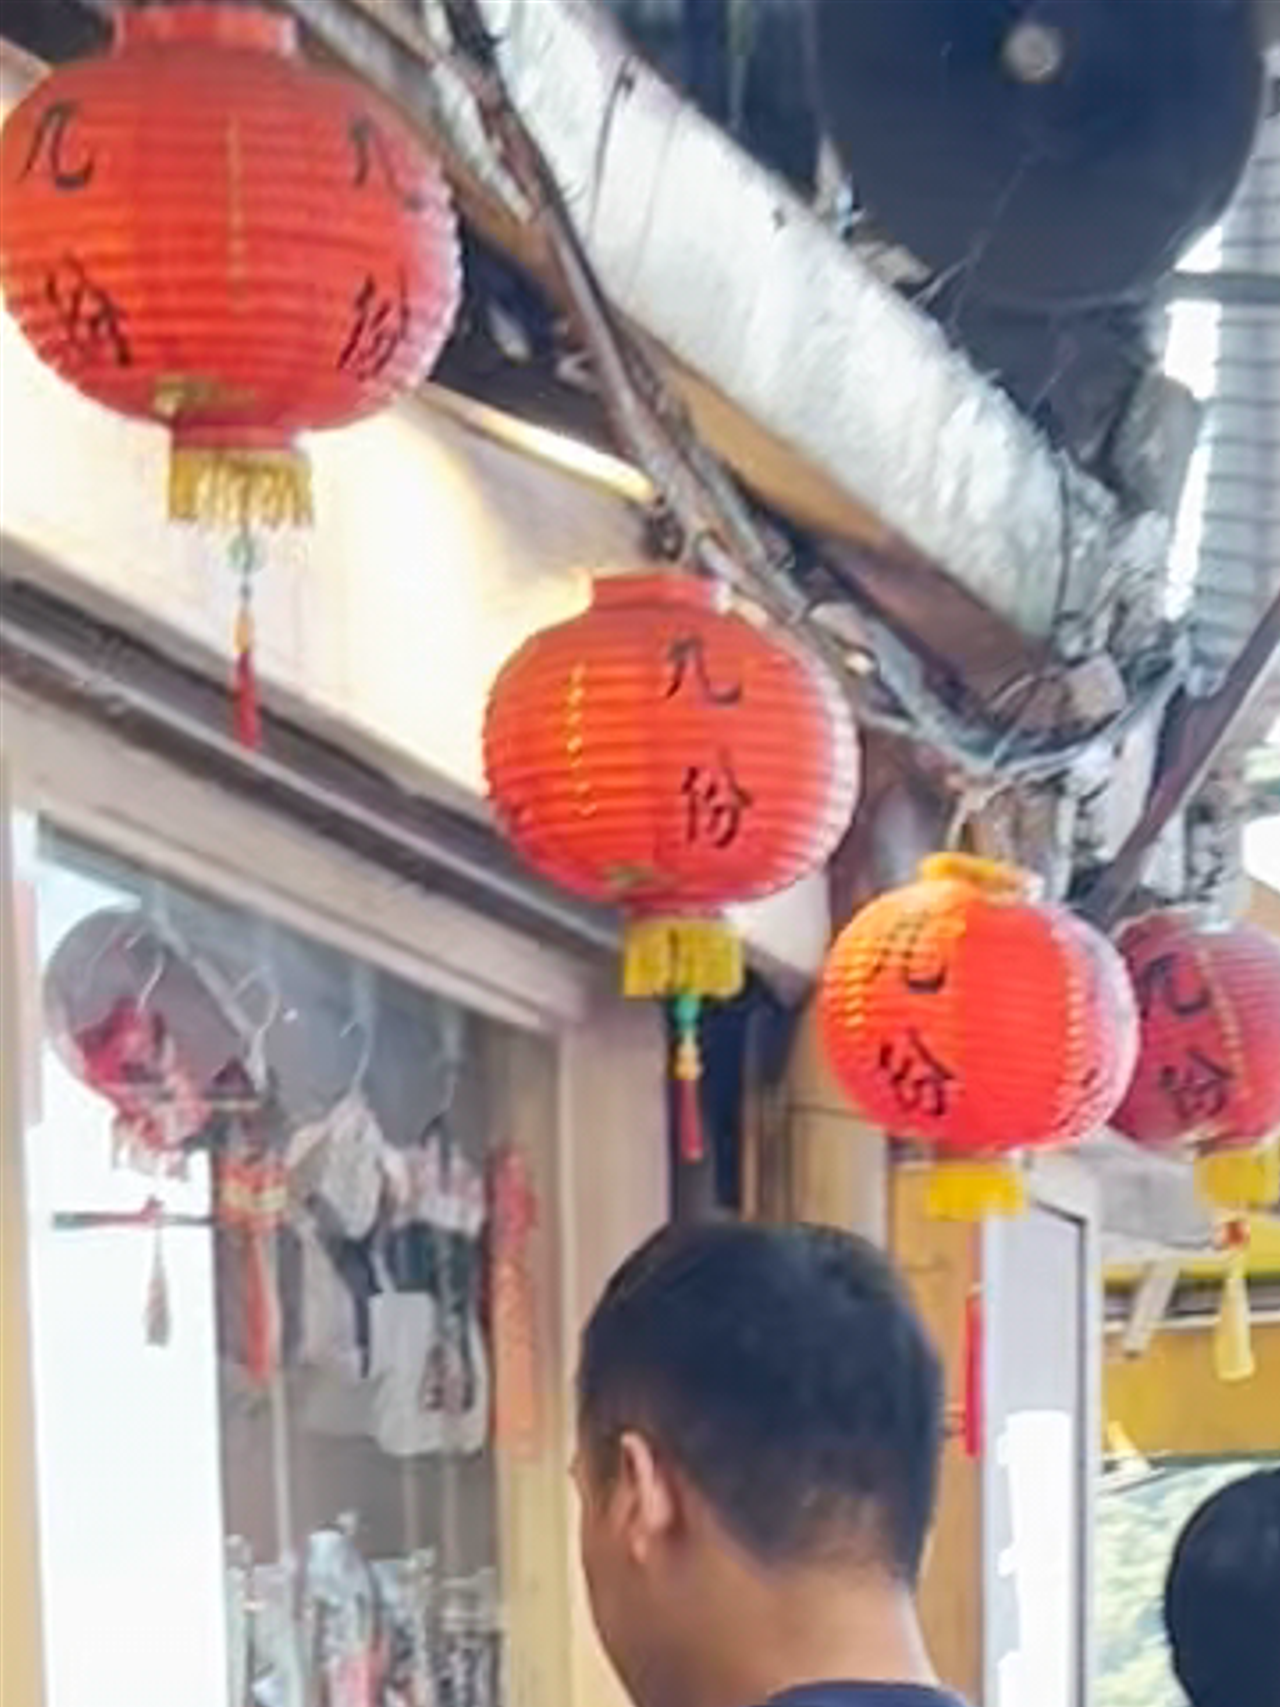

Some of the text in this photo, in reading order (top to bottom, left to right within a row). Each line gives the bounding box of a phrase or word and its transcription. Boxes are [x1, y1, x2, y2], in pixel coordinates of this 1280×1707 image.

[16, 98, 132, 368] 九份
[666, 632, 752, 848] 九份
[868, 910, 956, 1117] 九份
